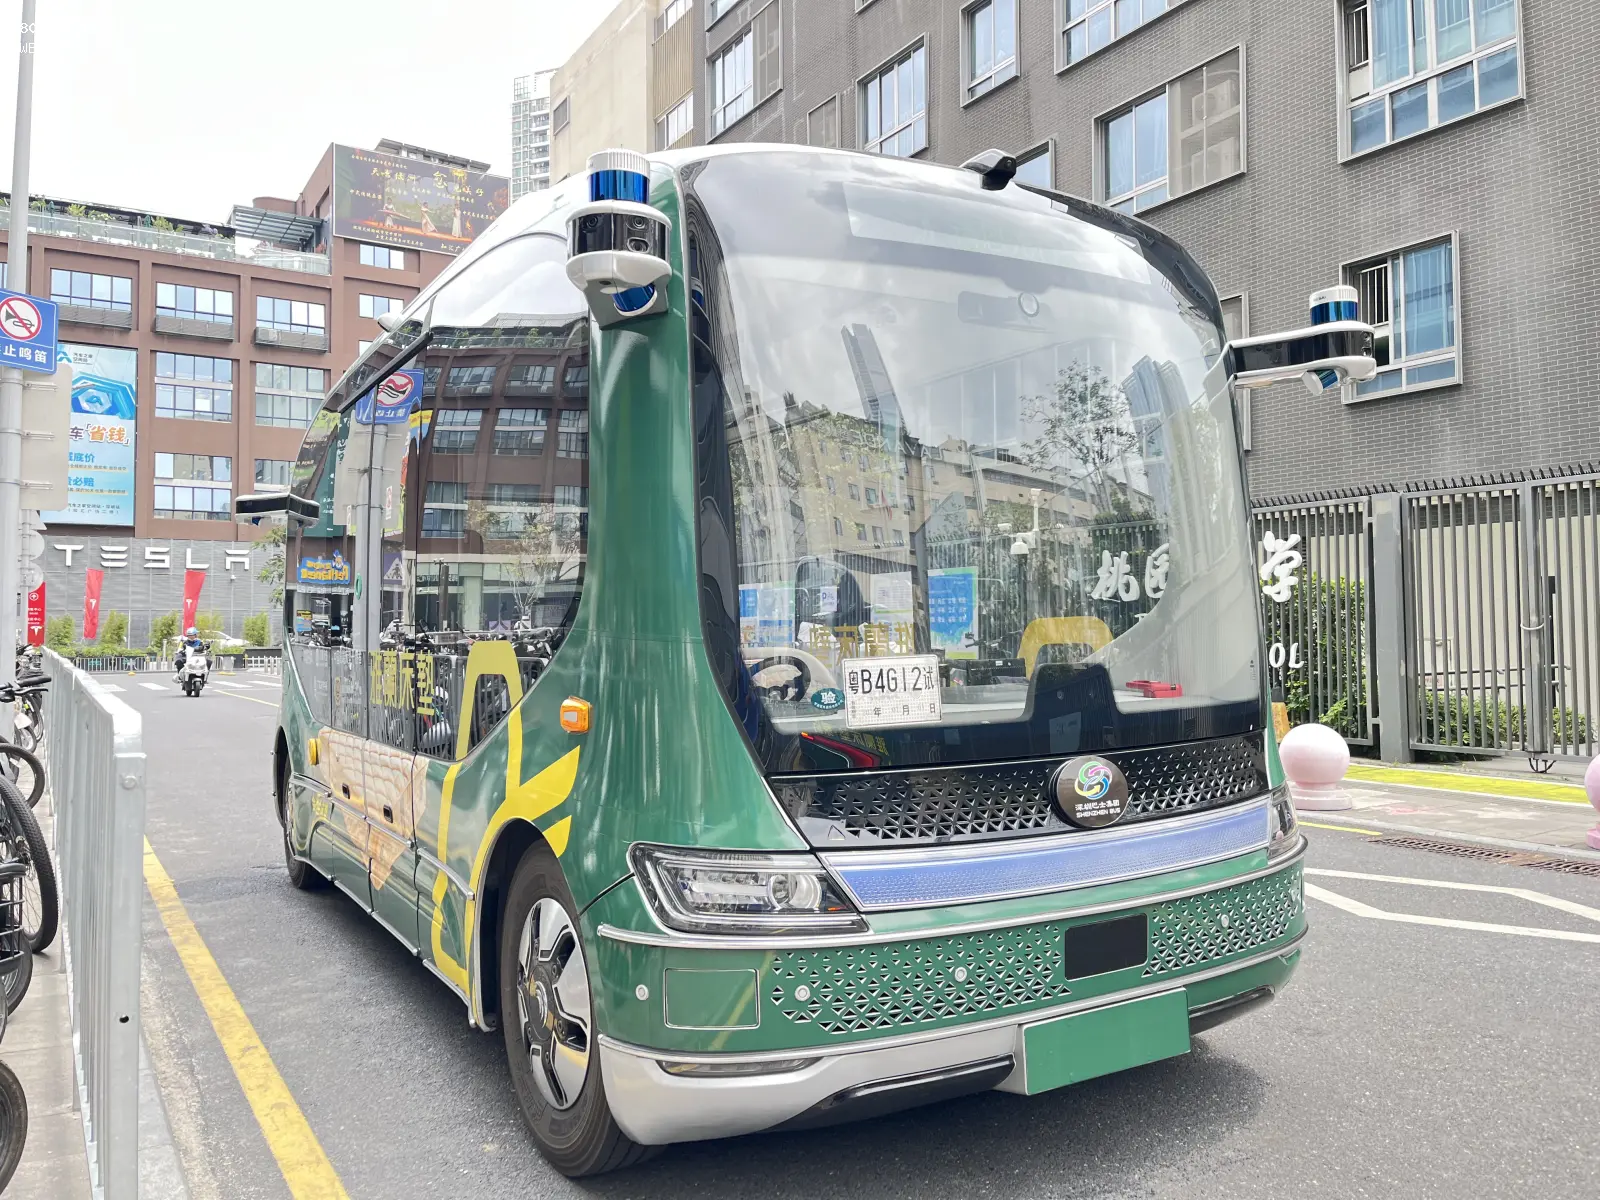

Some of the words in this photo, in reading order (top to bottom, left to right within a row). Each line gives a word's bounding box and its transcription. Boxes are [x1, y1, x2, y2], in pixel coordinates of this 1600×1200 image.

[0, 344, 47, 364] 止鸣笛
[54, 544, 250, 570] TESLA
